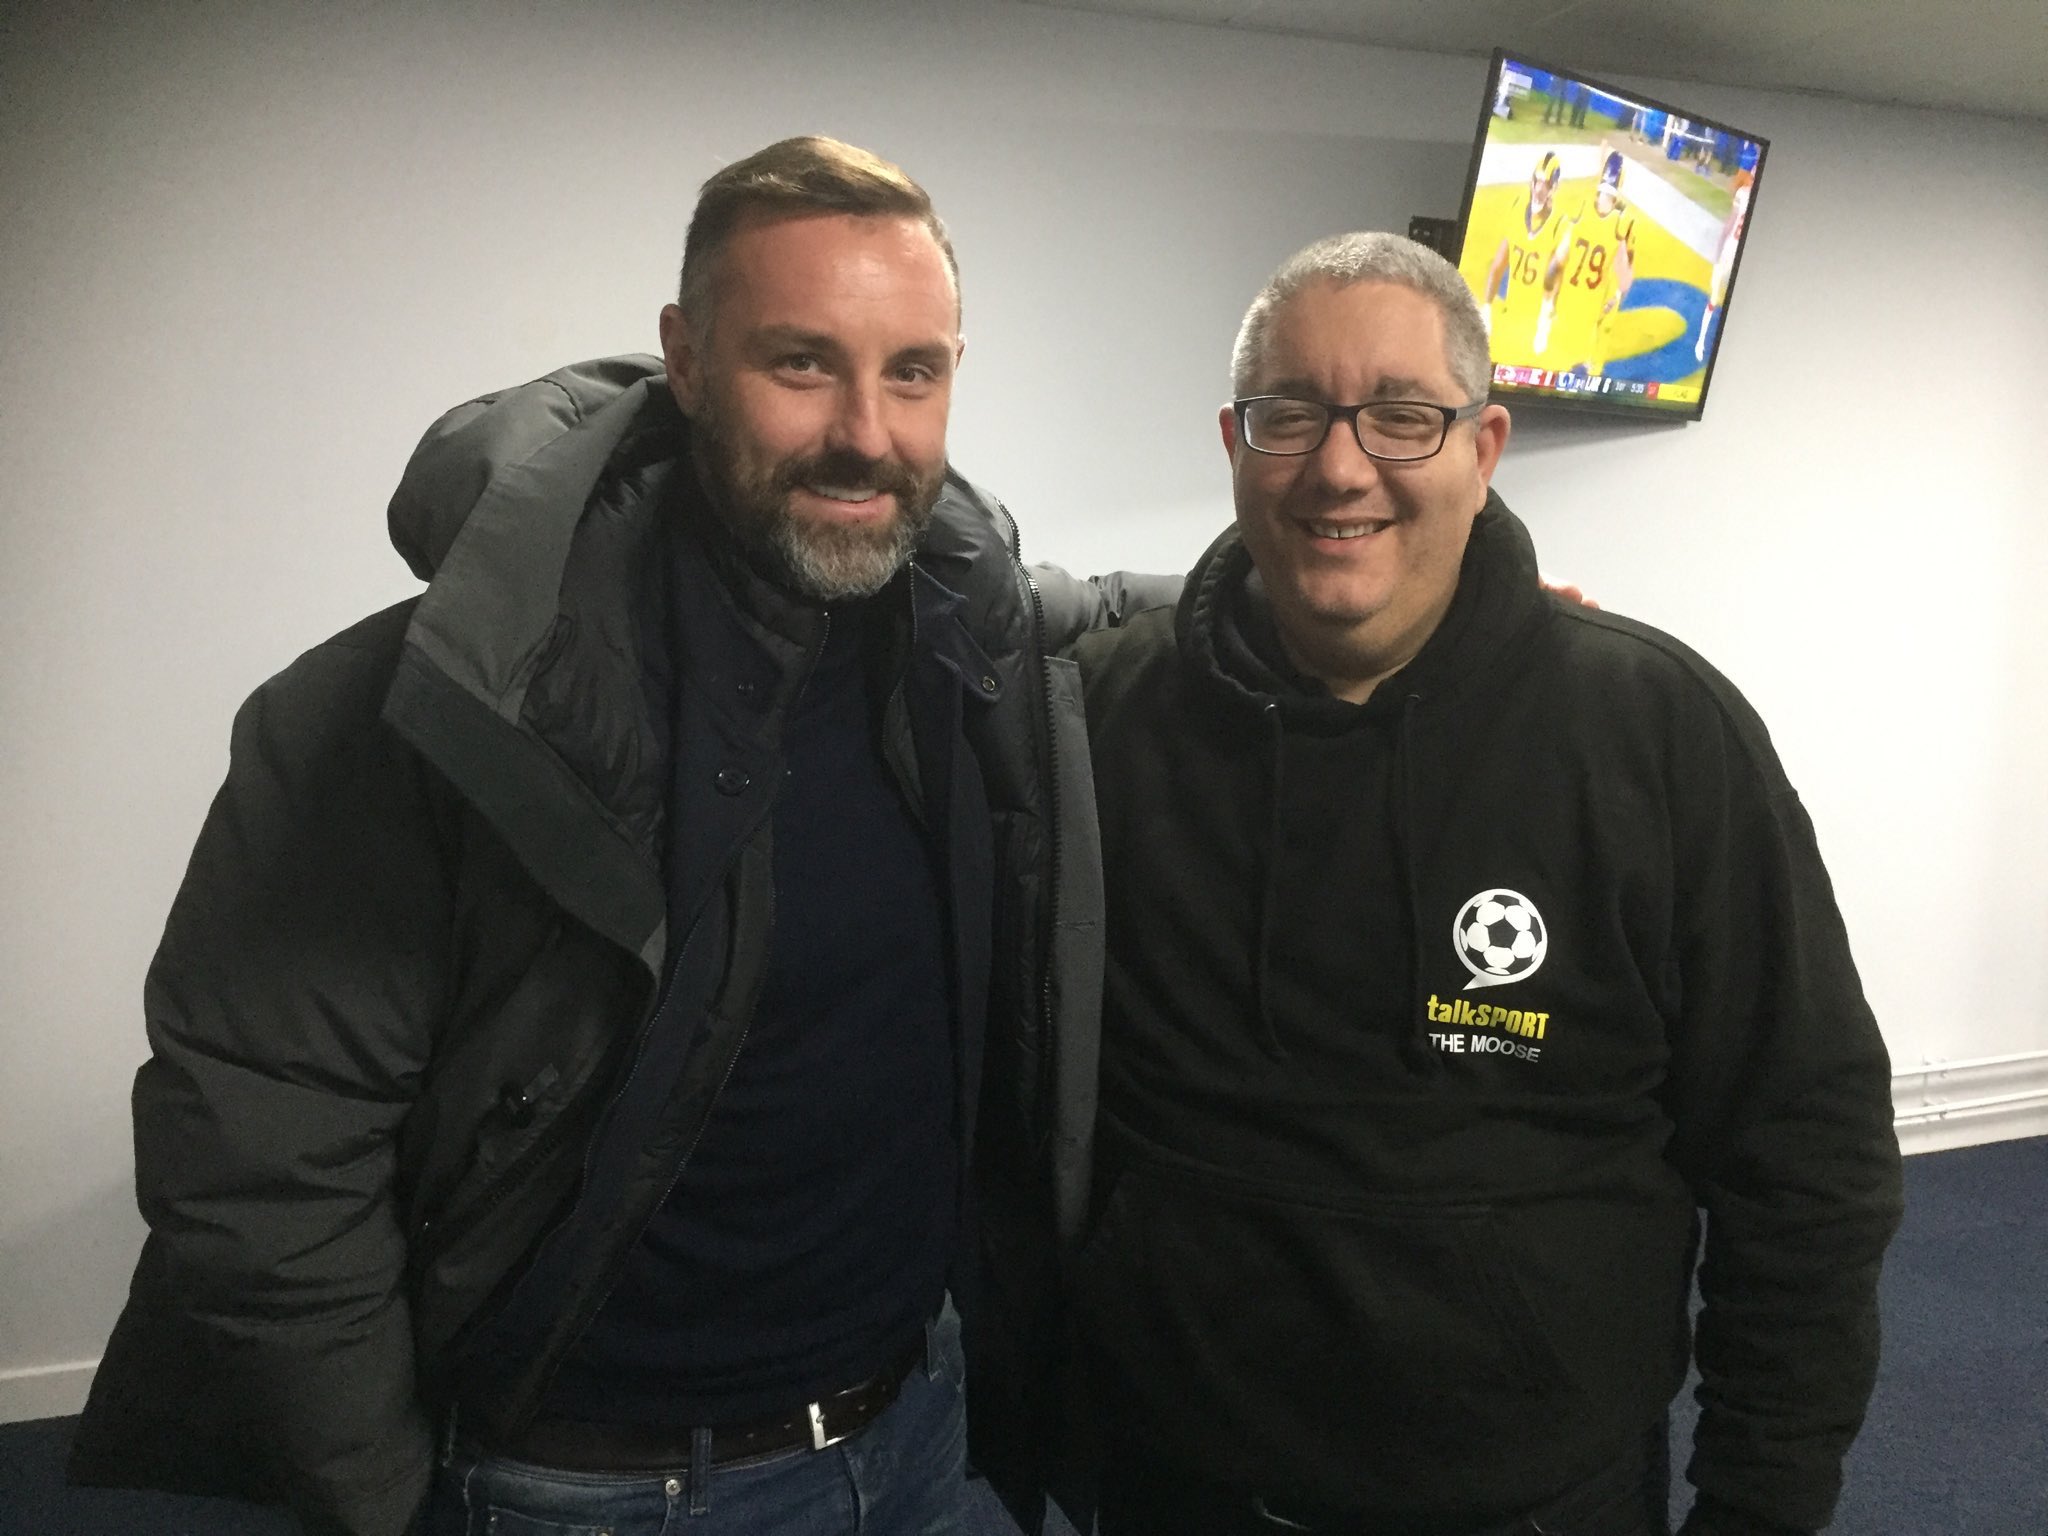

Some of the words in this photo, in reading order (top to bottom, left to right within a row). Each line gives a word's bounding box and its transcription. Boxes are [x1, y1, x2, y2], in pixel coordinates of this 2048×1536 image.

[1512, 244, 1539, 285] 76
[1569, 237, 1606, 290] 79
[1427, 994, 1550, 1039] talkSPORT
[1428, 1033, 1465, 1053] THE
[1470, 1034, 1541, 1063] MOOSE
